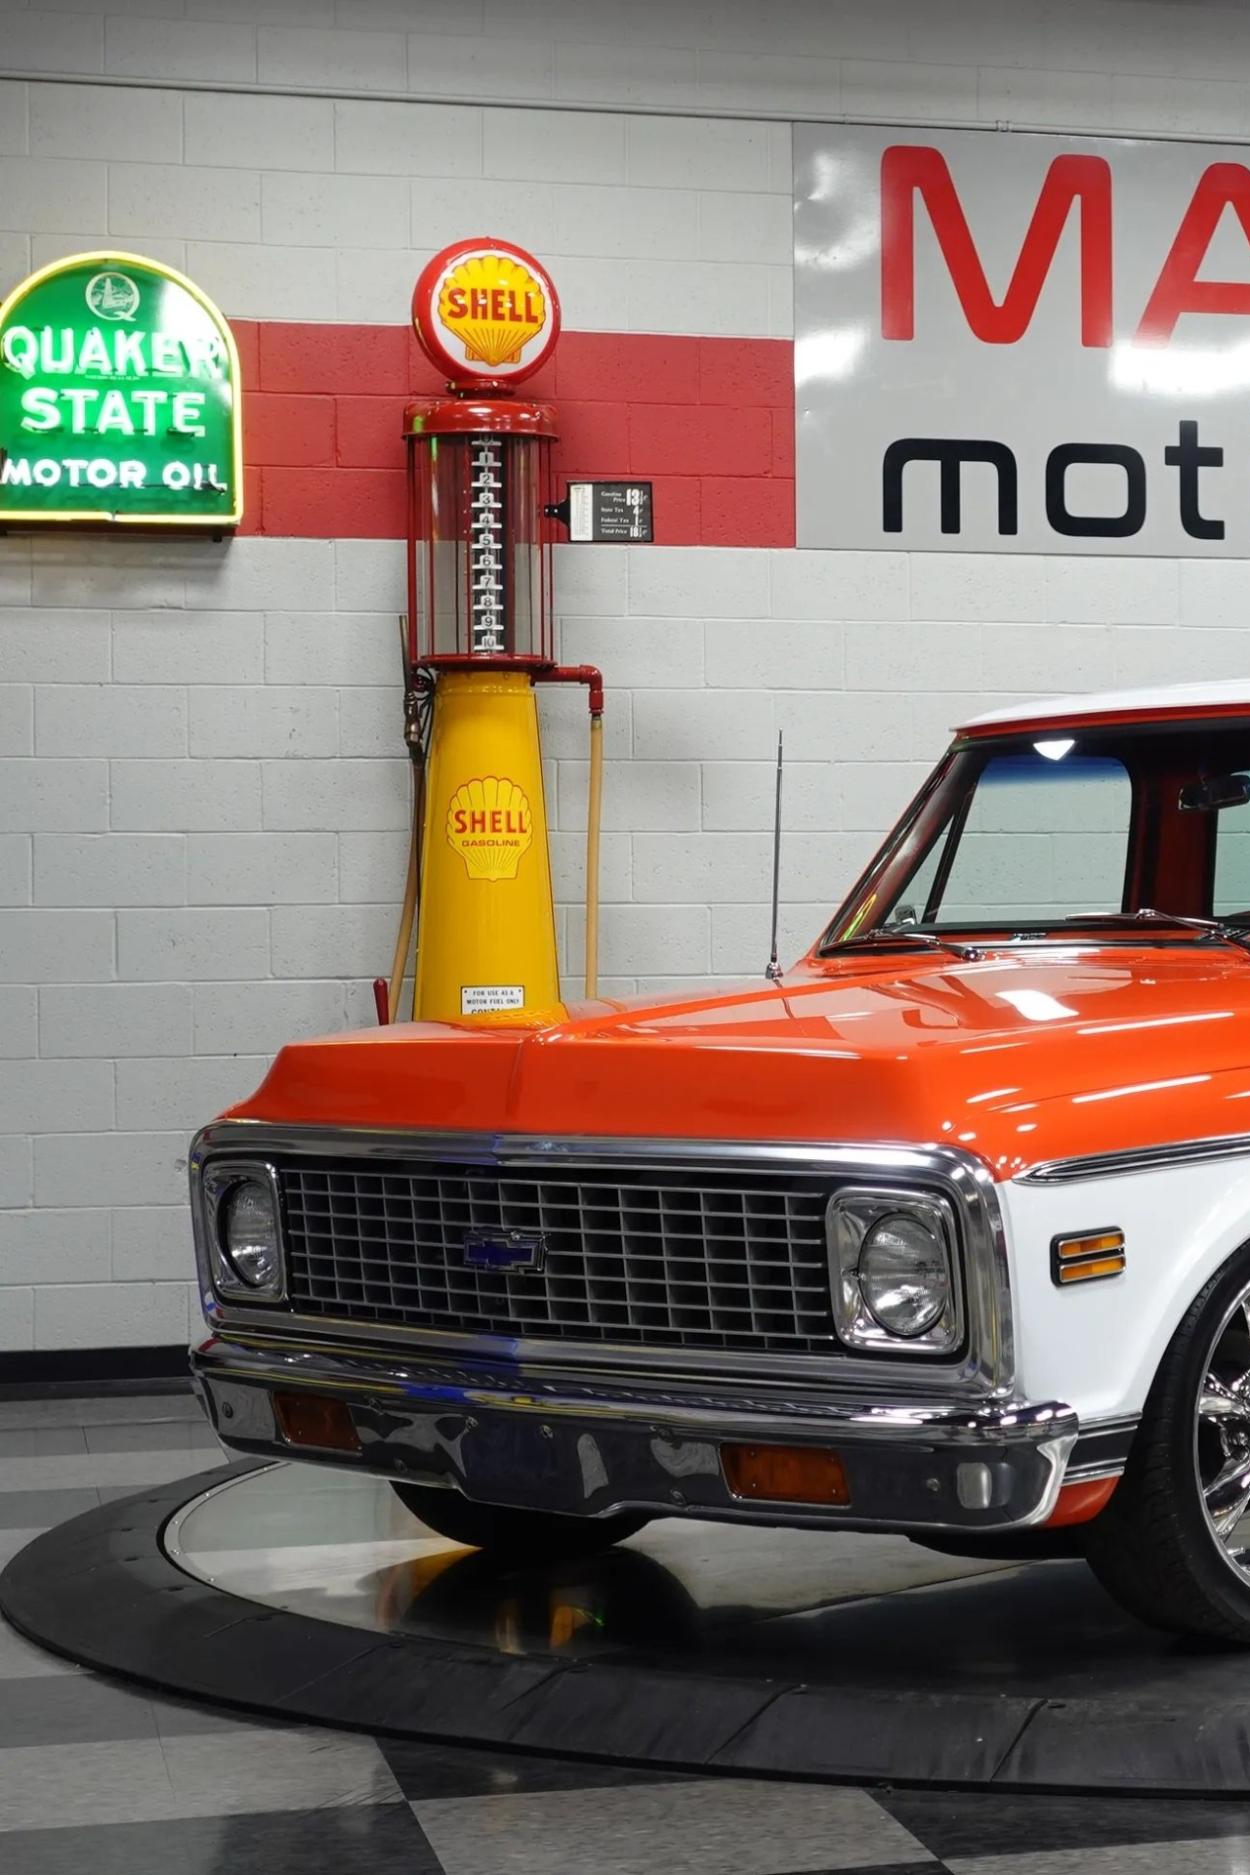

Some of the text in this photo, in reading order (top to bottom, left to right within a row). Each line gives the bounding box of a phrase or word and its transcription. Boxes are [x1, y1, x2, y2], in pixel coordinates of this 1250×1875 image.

[447, 288, 539, 323] SHELL
[1, 325, 227, 380] QUAKER
[20, 386, 206, 438] STATE
[0, 457, 228, 492] MOTOR OIL
[482, 474, 490, 484] 2
[482, 494, 490, 504] 3
[482, 516, 489, 525] 4
[483, 536, 490, 545] 5
[483, 556, 491, 566] 6
[484, 577, 491, 587] 7
[484, 597, 492, 607] 8
[485, 616, 492, 627] 9
[454, 810, 527, 833] SHELL
